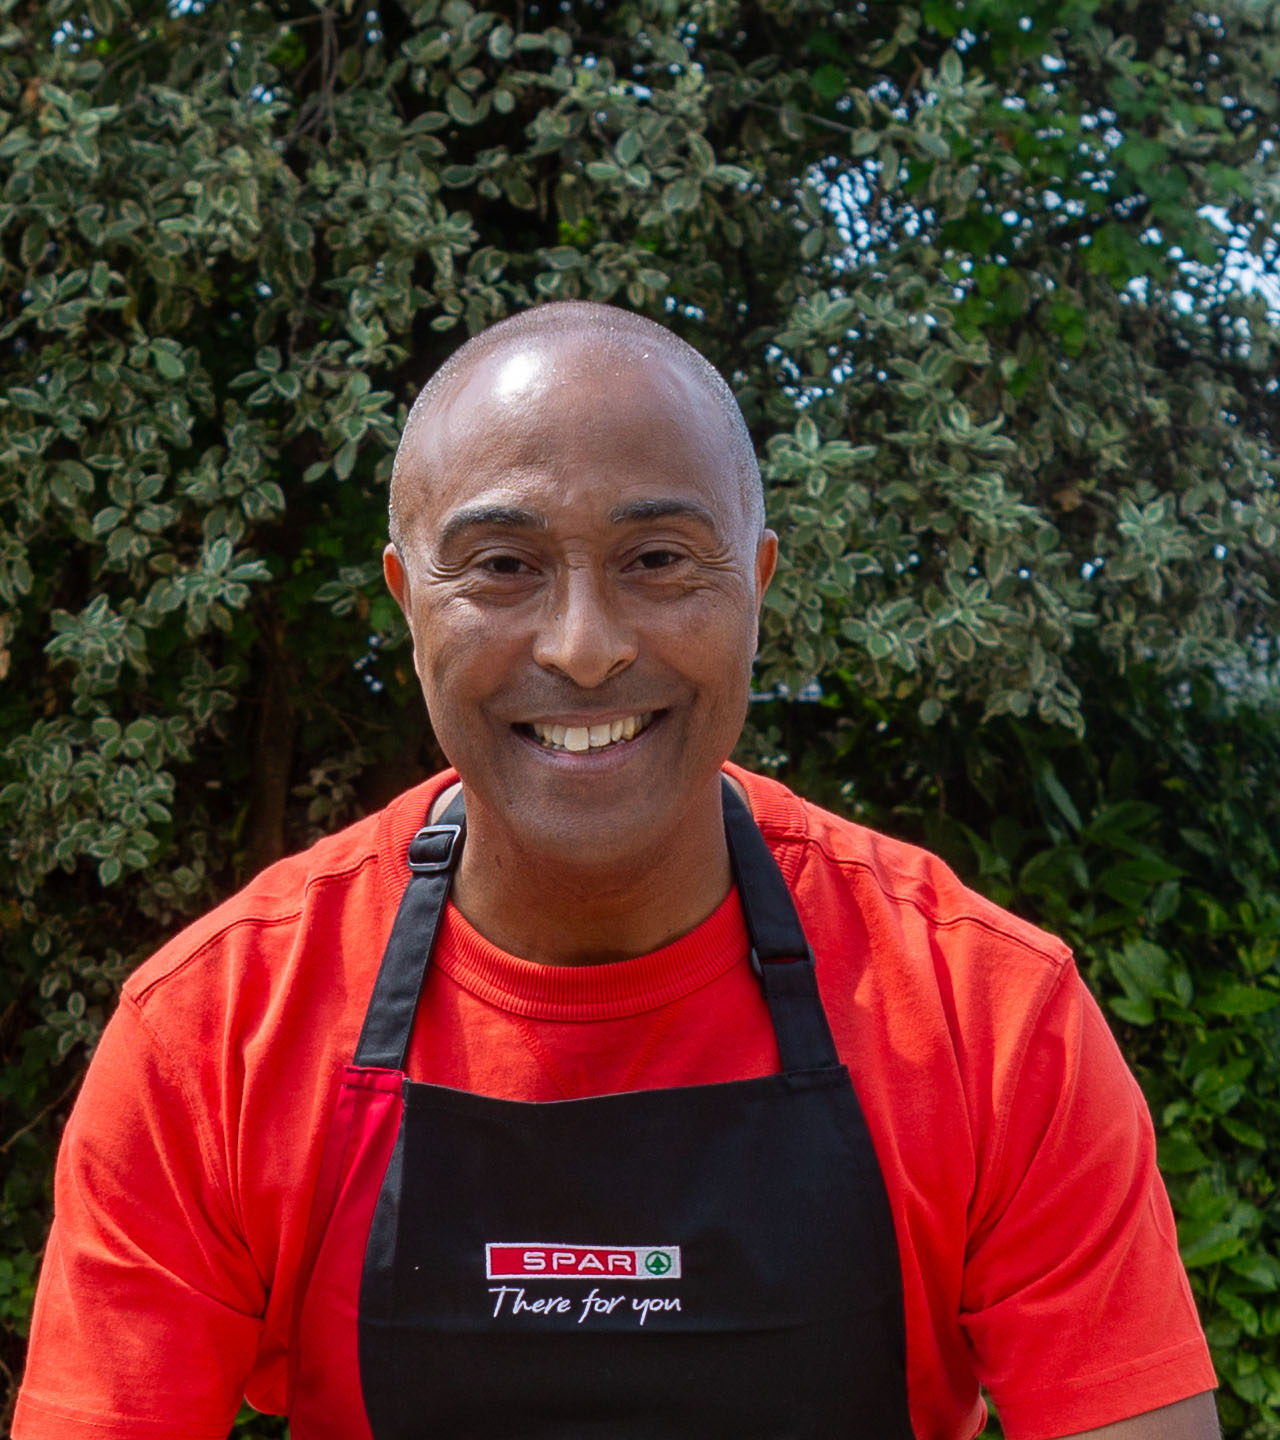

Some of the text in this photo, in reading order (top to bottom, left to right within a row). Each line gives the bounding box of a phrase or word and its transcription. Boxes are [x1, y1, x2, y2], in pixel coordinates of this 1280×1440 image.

[523, 1251, 632, 1272] SPAR
[488, 1286, 681, 1325] There for you
